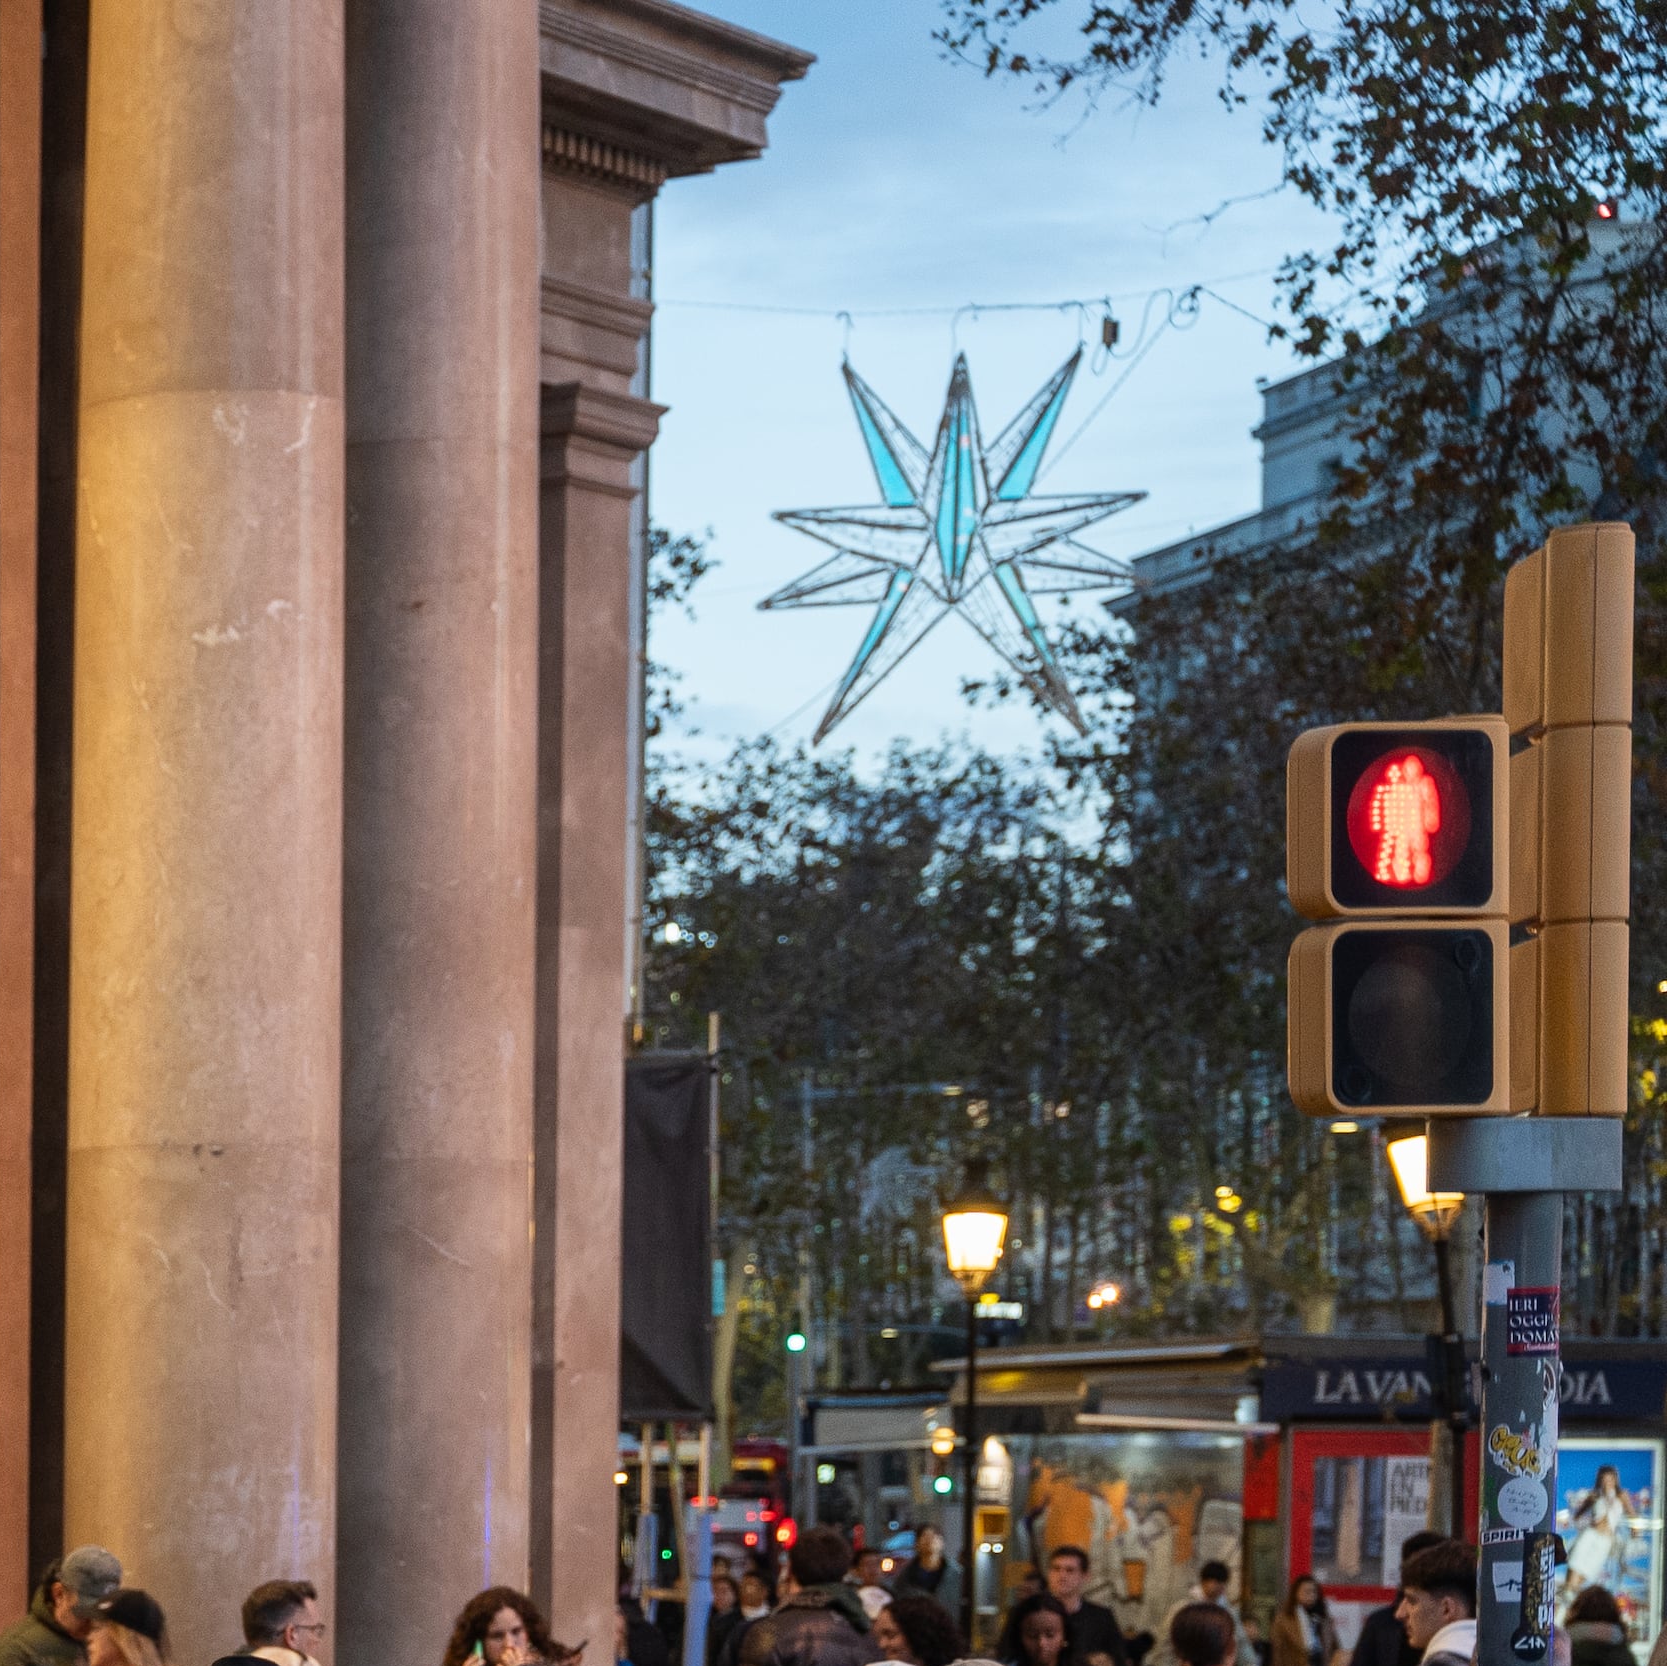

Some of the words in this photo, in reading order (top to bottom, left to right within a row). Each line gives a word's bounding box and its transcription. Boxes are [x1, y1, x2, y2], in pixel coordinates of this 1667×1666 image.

[1509, 1297, 1538, 1312] IERI
[1314, 1370, 1362, 1404] LA
[1363, 1369, 1612, 1405] VANDIA
[1483, 1529, 1530, 1545] SPIRIT
